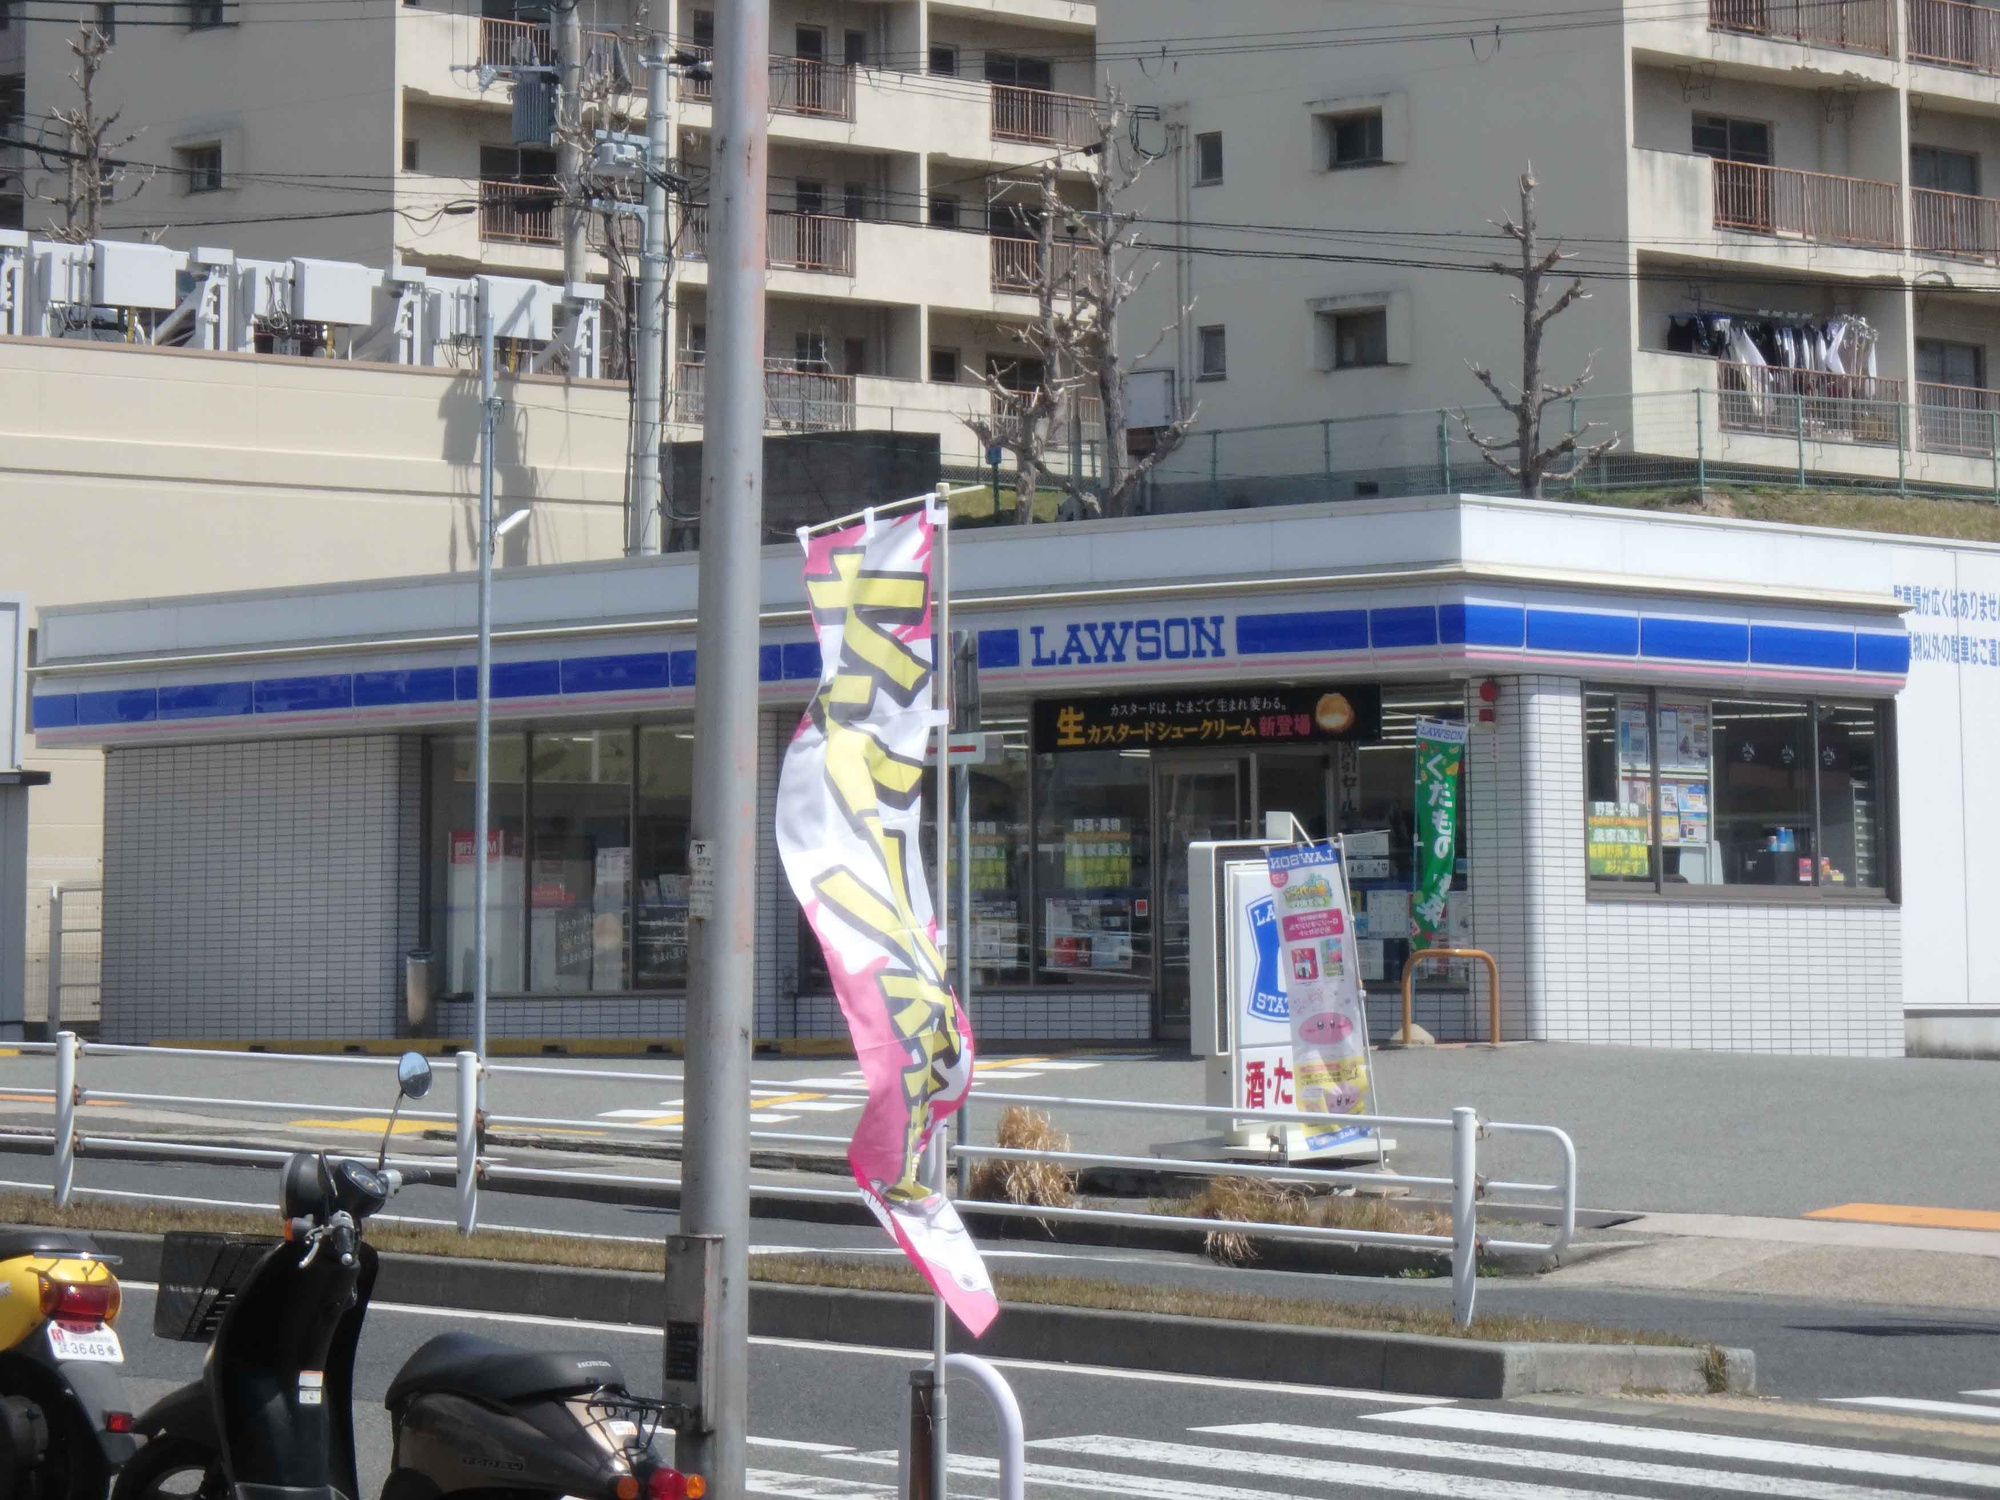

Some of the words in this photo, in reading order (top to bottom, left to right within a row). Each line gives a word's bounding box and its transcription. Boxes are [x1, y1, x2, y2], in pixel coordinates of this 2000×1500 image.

[1893, 585, 2000, 622] 車場が広くはありませ
[1030, 615, 1226, 667] LAWSON
[1908, 631, 2000, 667] 物以外の駐車はご遠
[1057, 706, 1086, 746] 生
[1087, 715, 1257, 744] カスタードシュークリーム
[1259, 714, 1312, 737] 新登場
[1419, 726, 1466, 742] LAWSON
[1425, 754, 1454, 860] くだもの
[1254, 904, 1276, 927] LA
[1244, 1056, 1294, 1110] 酒・た
[70, 1343, 105, 1356] 3648
[576, 1360, 613, 1370] HONDA
